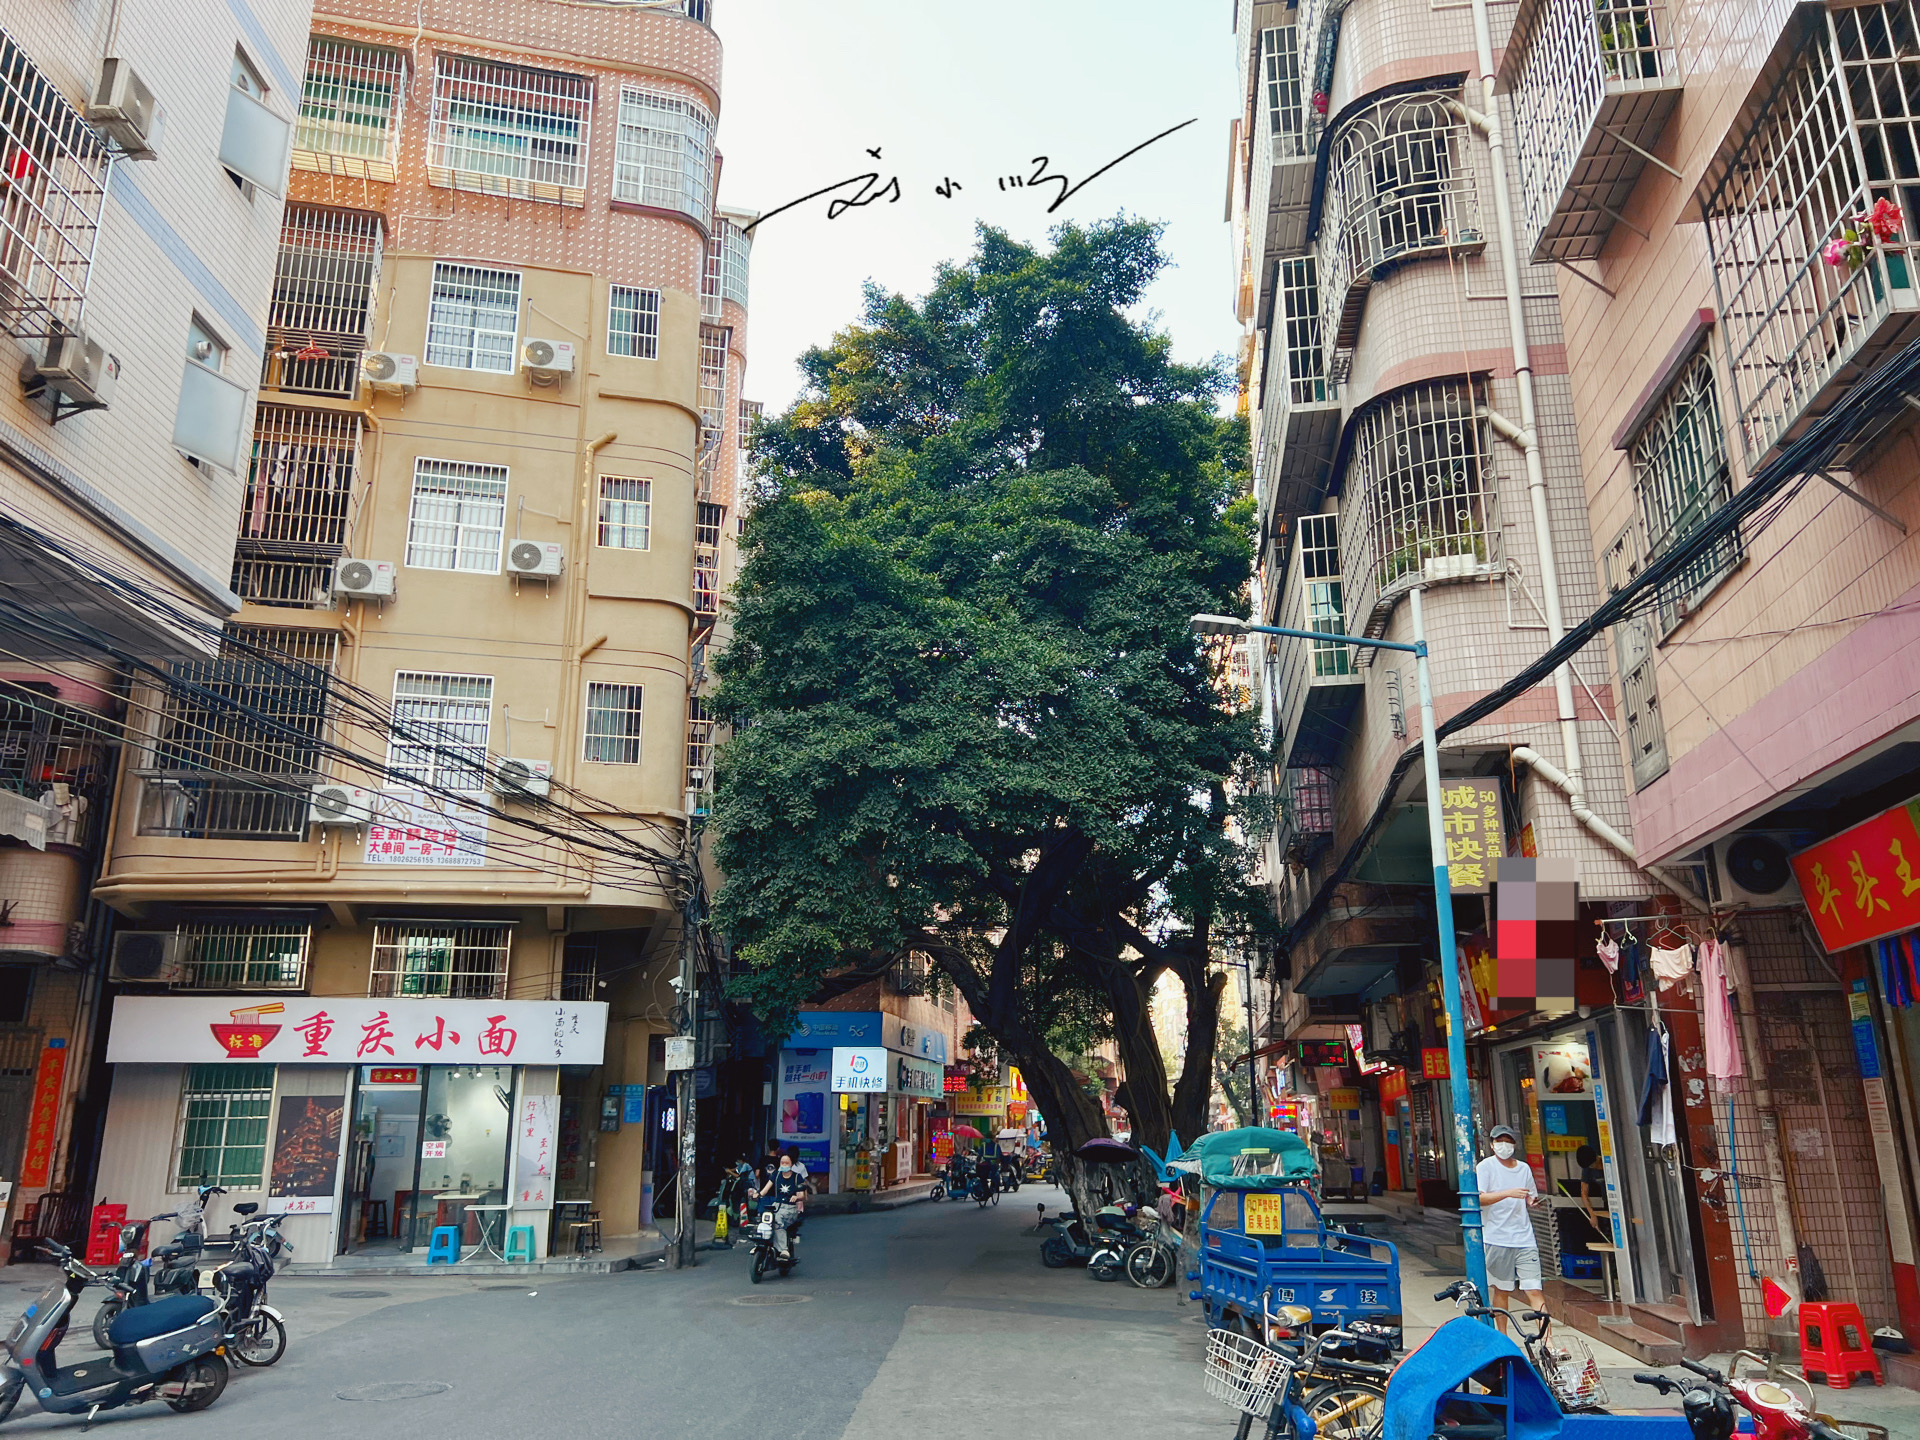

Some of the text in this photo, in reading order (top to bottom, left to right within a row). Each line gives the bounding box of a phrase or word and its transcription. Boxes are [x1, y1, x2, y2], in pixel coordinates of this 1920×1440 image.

[1441, 786, 1486, 888] 城市快餐
[369, 841, 456, 856] 大单间 一房一厅
[229, 1033, 263, 1049] 标准
[293, 1010, 518, 1058] 重庆小面
[1424, 1051, 1451, 1076] 自选
[835, 1075, 884, 1089] 手机快修
[525, 1101, 537, 1137] 行千里
[537, 1138, 548, 1176] 至广大
[521, 1189, 544, 1202] 重庆
[284, 1200, 316, 1211] 洪崖洞
[1248, 1214, 1280, 1231] 后果自负
[1278, 1287, 1377, 1304] 博 技
